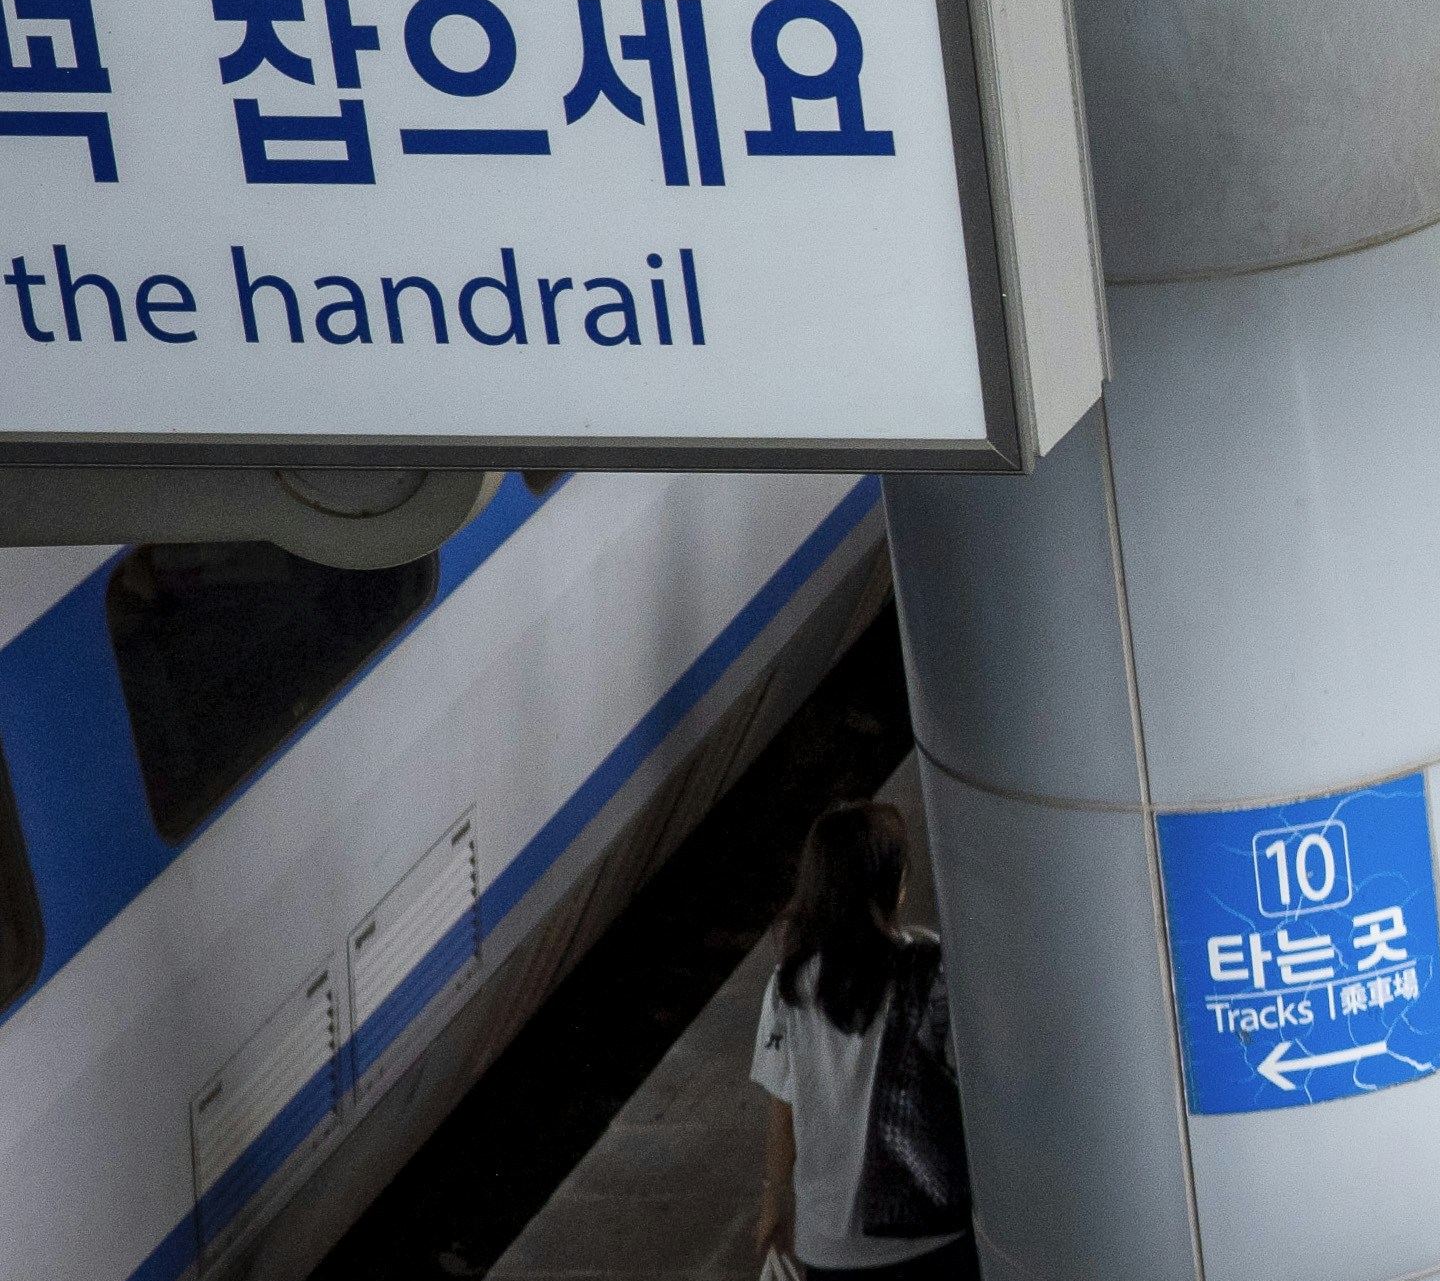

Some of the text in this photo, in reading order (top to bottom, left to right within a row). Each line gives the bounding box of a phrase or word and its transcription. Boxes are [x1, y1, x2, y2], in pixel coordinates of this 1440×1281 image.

[4, 243, 707, 347] the handrail
[1265, 833, 1335, 906] 10
[1207, 905, 1408, 989] 타는 곳
[1206, 994, 1314, 1033] Tracks
